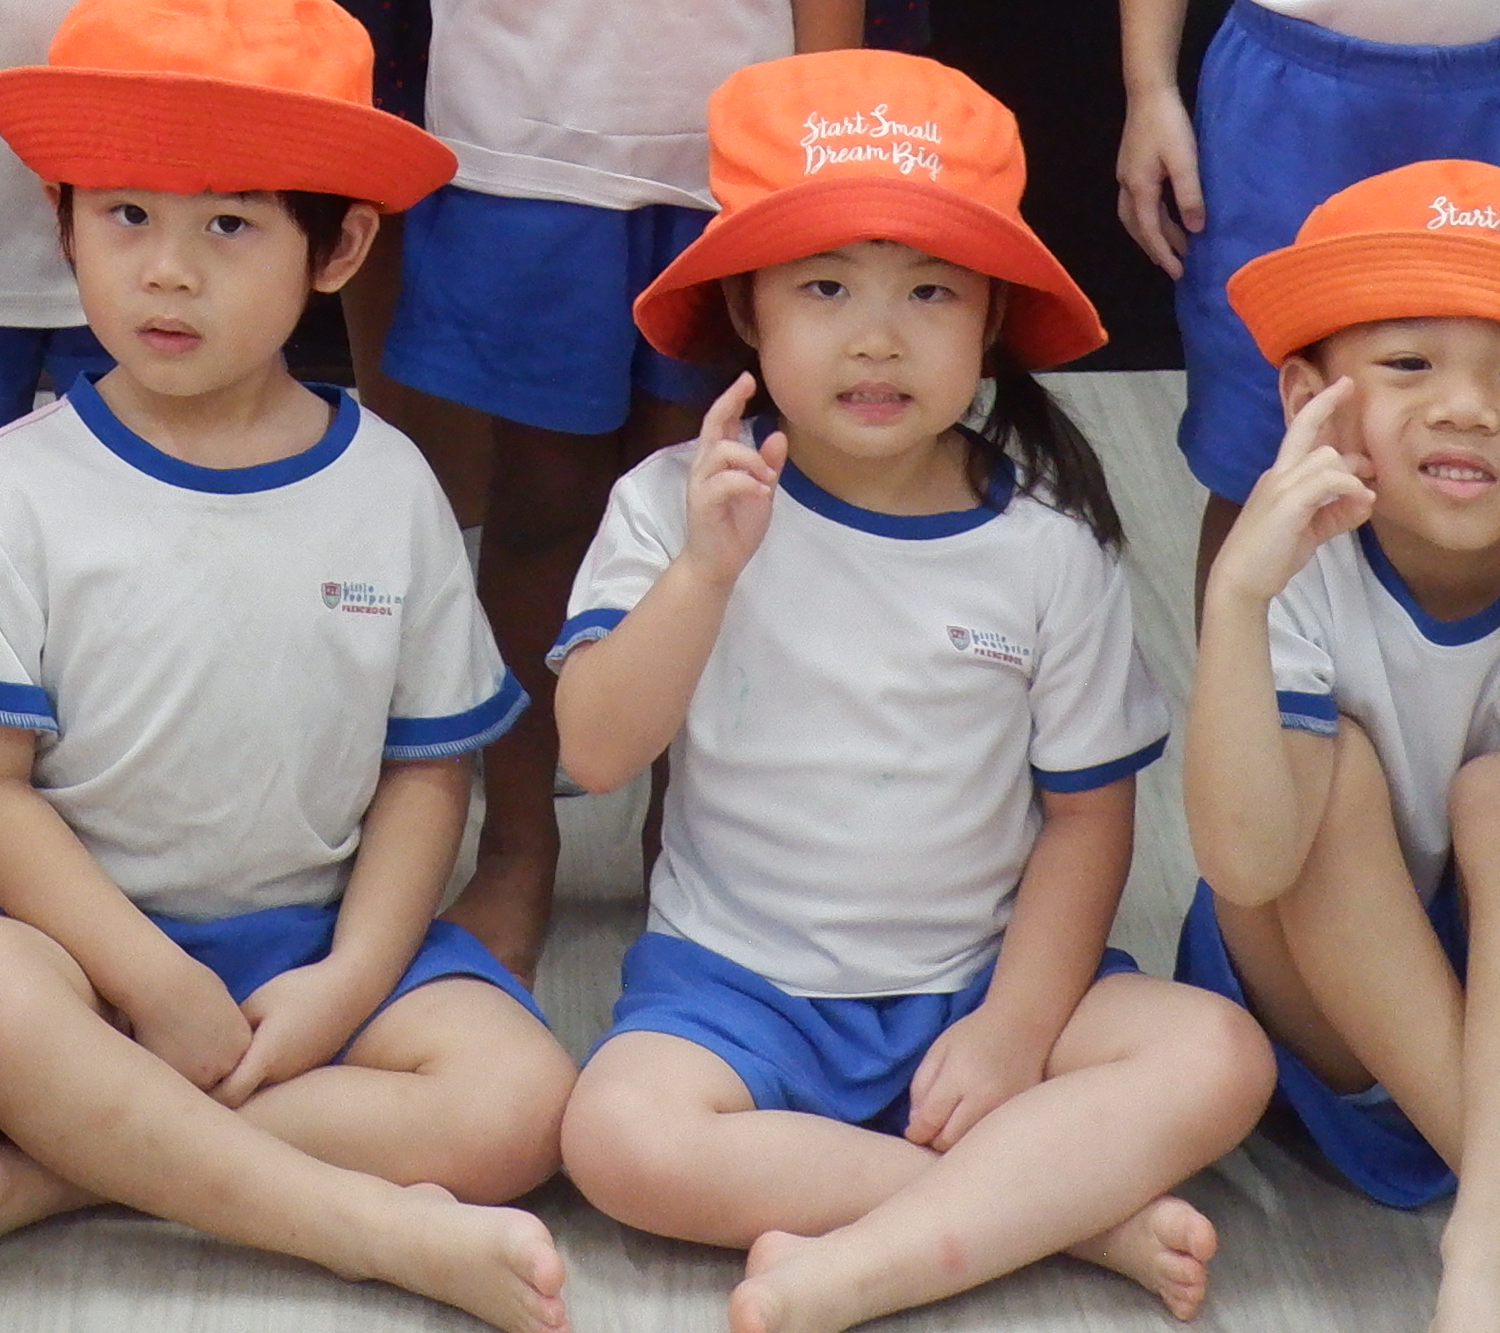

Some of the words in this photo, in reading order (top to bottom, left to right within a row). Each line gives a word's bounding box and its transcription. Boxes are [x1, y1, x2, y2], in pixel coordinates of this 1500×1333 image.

[801, 113, 868, 148] Start
[867, 102, 943, 144] Small
[802, 142, 891, 175] Dream
[890, 142, 943, 182] Big
[1427, 196, 1500, 234] Start
